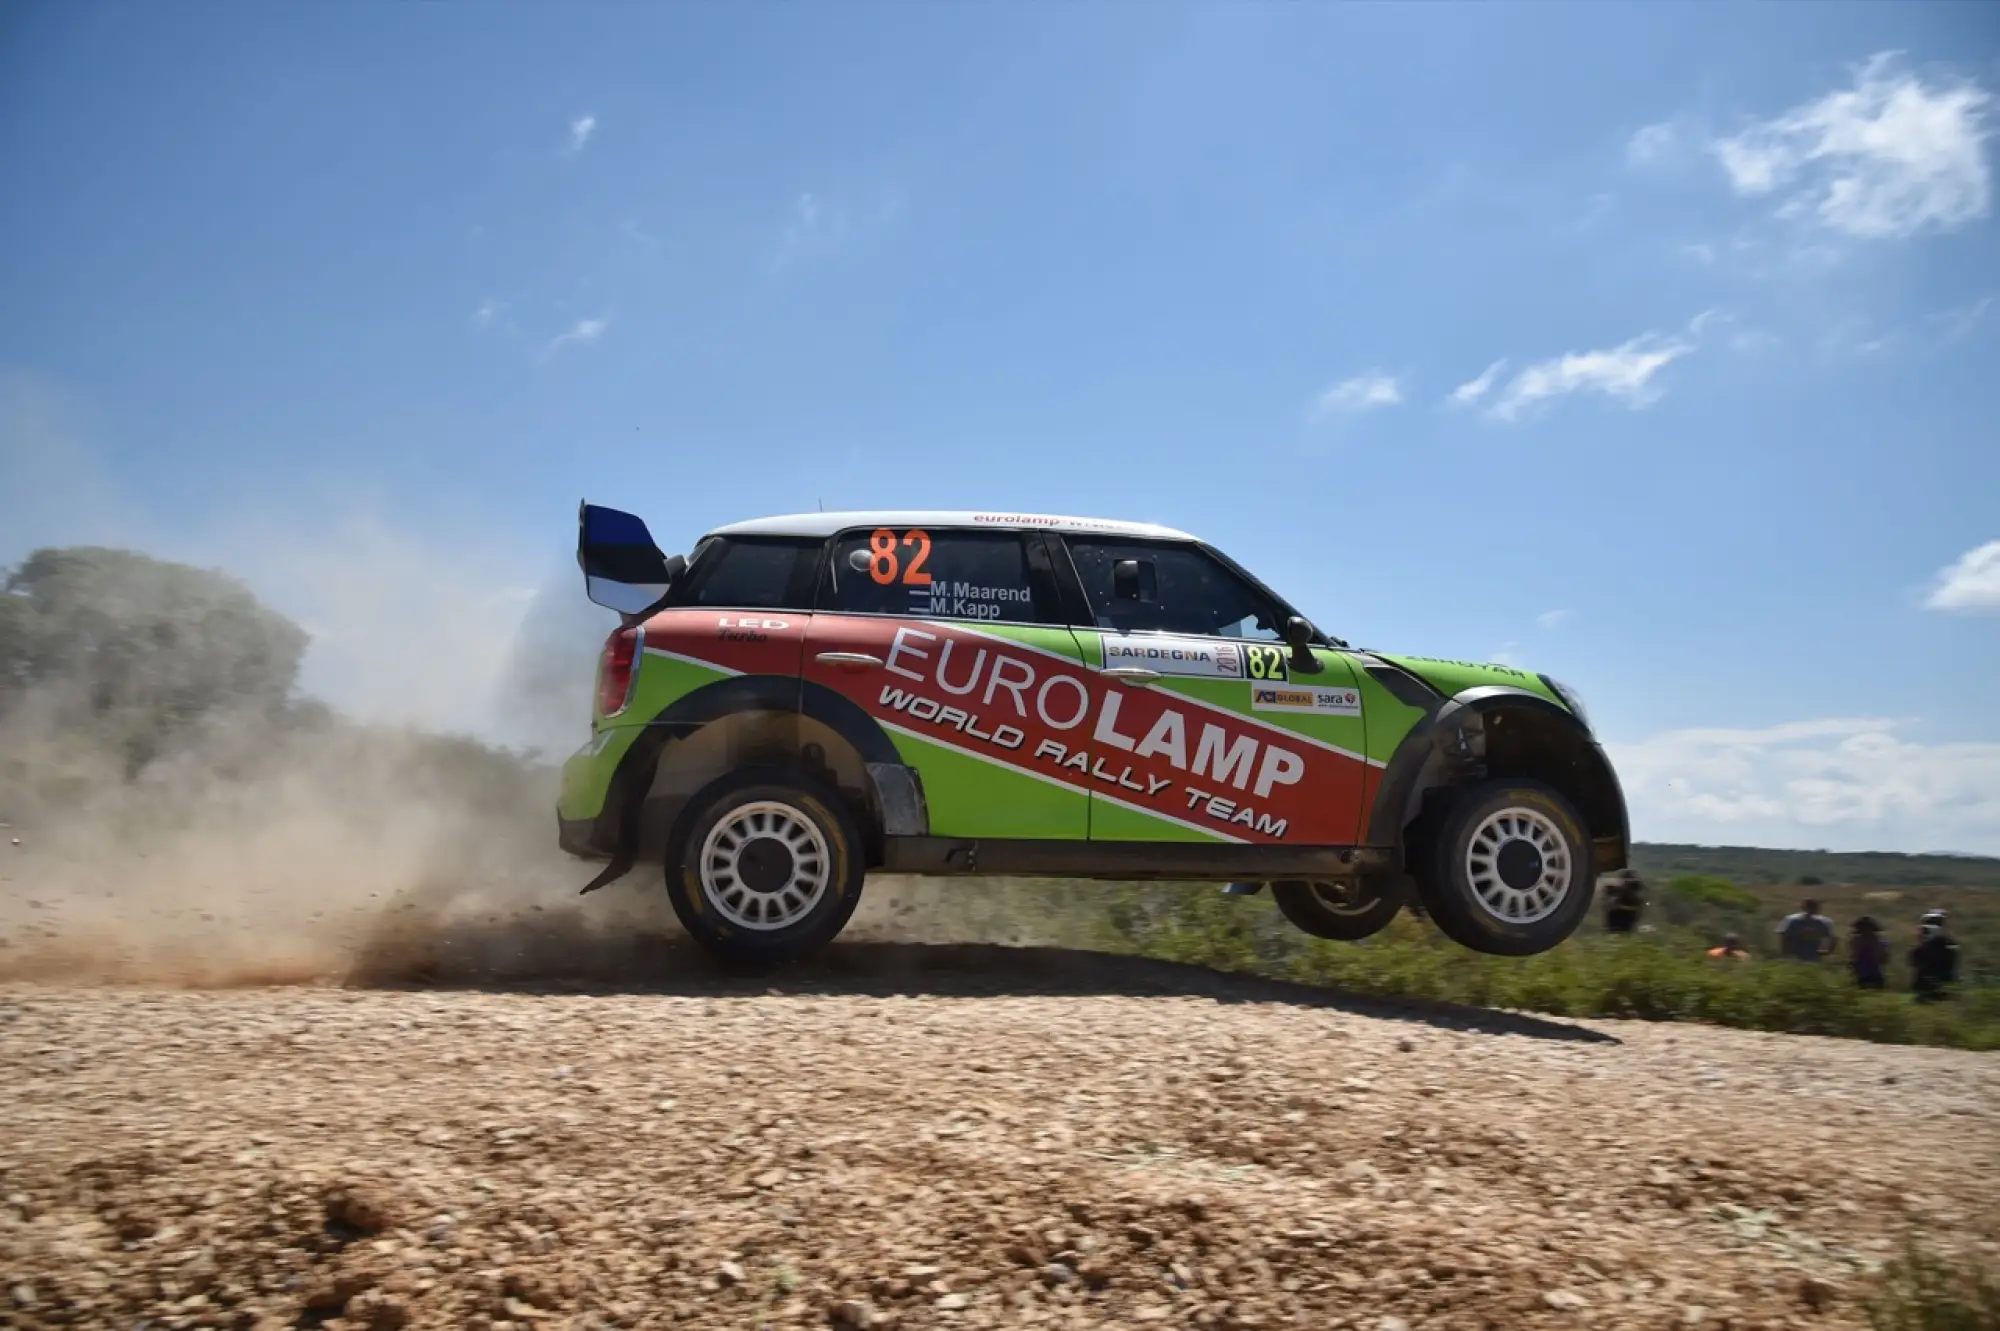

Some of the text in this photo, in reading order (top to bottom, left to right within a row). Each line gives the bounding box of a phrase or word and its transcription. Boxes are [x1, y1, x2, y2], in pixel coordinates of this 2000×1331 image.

[973, 514, 1061, 526] eurolamp
[869, 527, 932, 585] 82
[930, 580, 1031, 602] M. Maarend
[930, 597, 1001, 620] M. Kapp
[718, 617, 790, 630] LED
[1108, 646, 1212, 663] SARDEGNA
[1214, 646, 1238, 673] 2016
[1246, 646, 1284, 680] 82
[1276, 693, 1313, 704] GLOBAL
[1316, 693, 1343, 704] sara
[885, 627, 1305, 799] EUROLAMP
[878, 684, 1289, 840] WORLD RALLY TEAM
